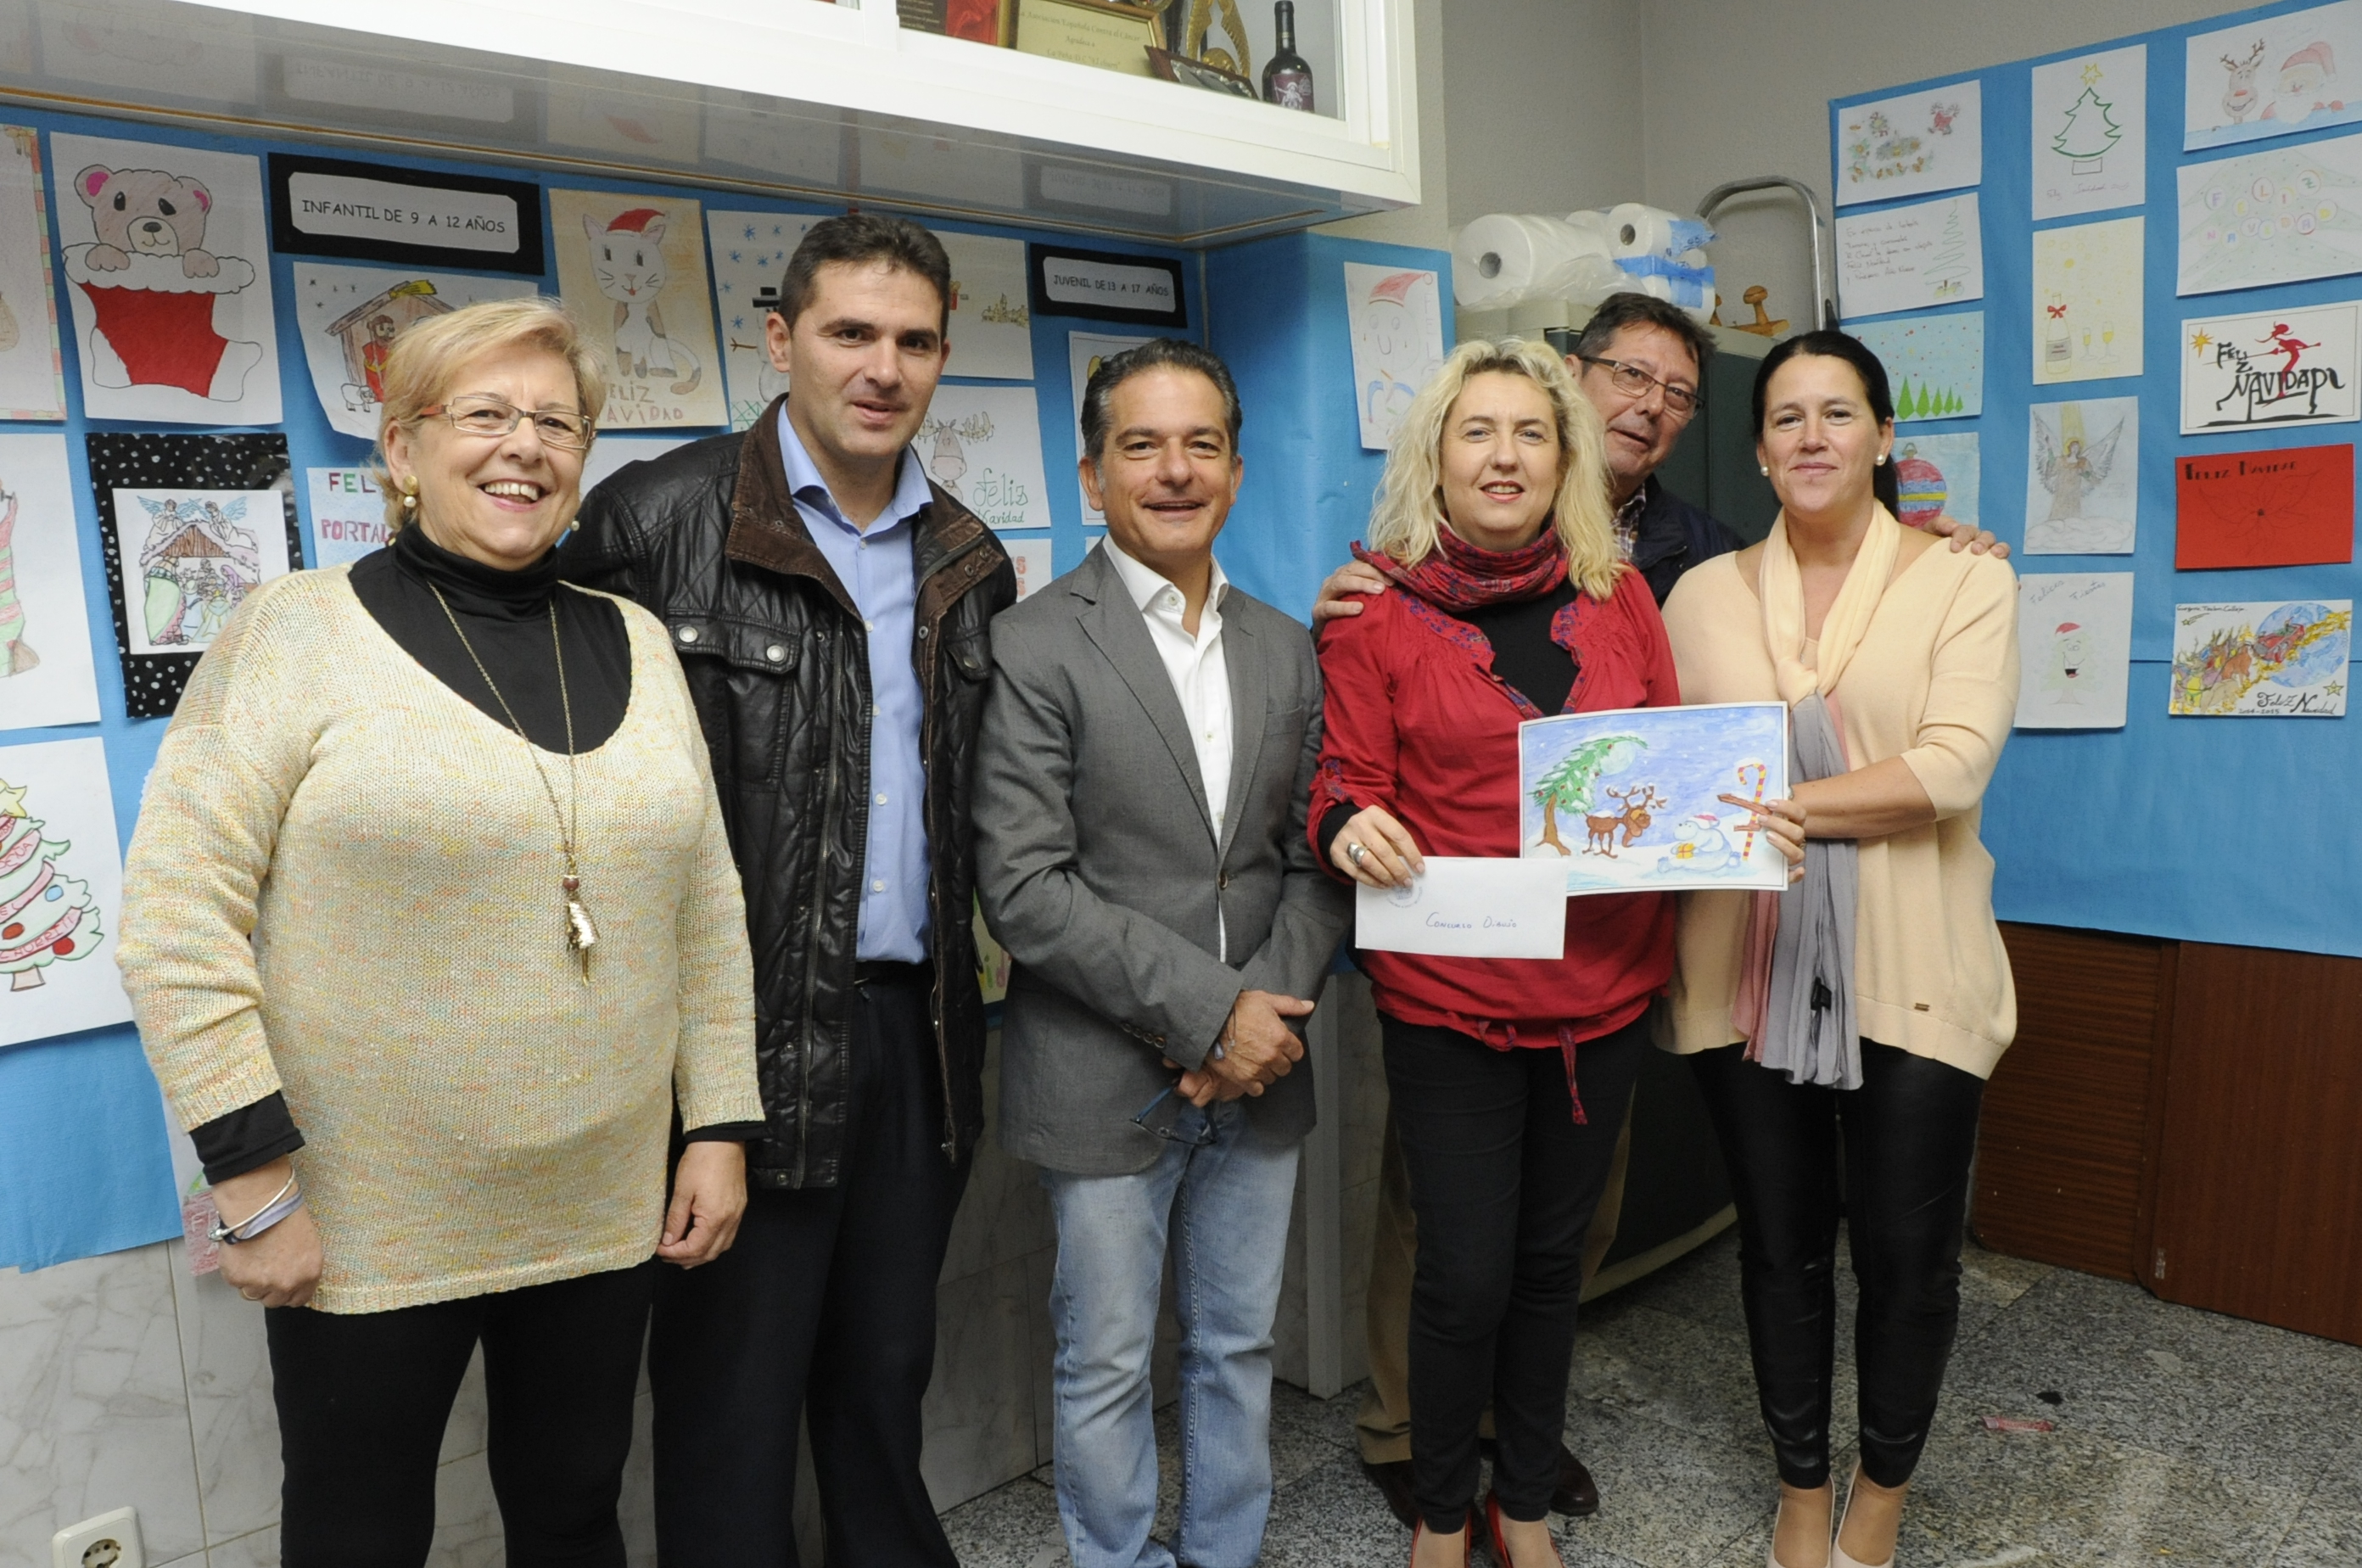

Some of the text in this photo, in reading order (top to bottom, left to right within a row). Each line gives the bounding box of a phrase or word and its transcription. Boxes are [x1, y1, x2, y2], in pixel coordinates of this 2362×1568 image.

[301, 199, 506, 233] INFANTIL DE 9 A 12 AÑOS
[1053, 275, 1169, 296] JUVENIL DE 13 A 17 AÑOS
[607, 379, 655, 404] ELIZ
[598, 403, 684, 424] AVIDAD
